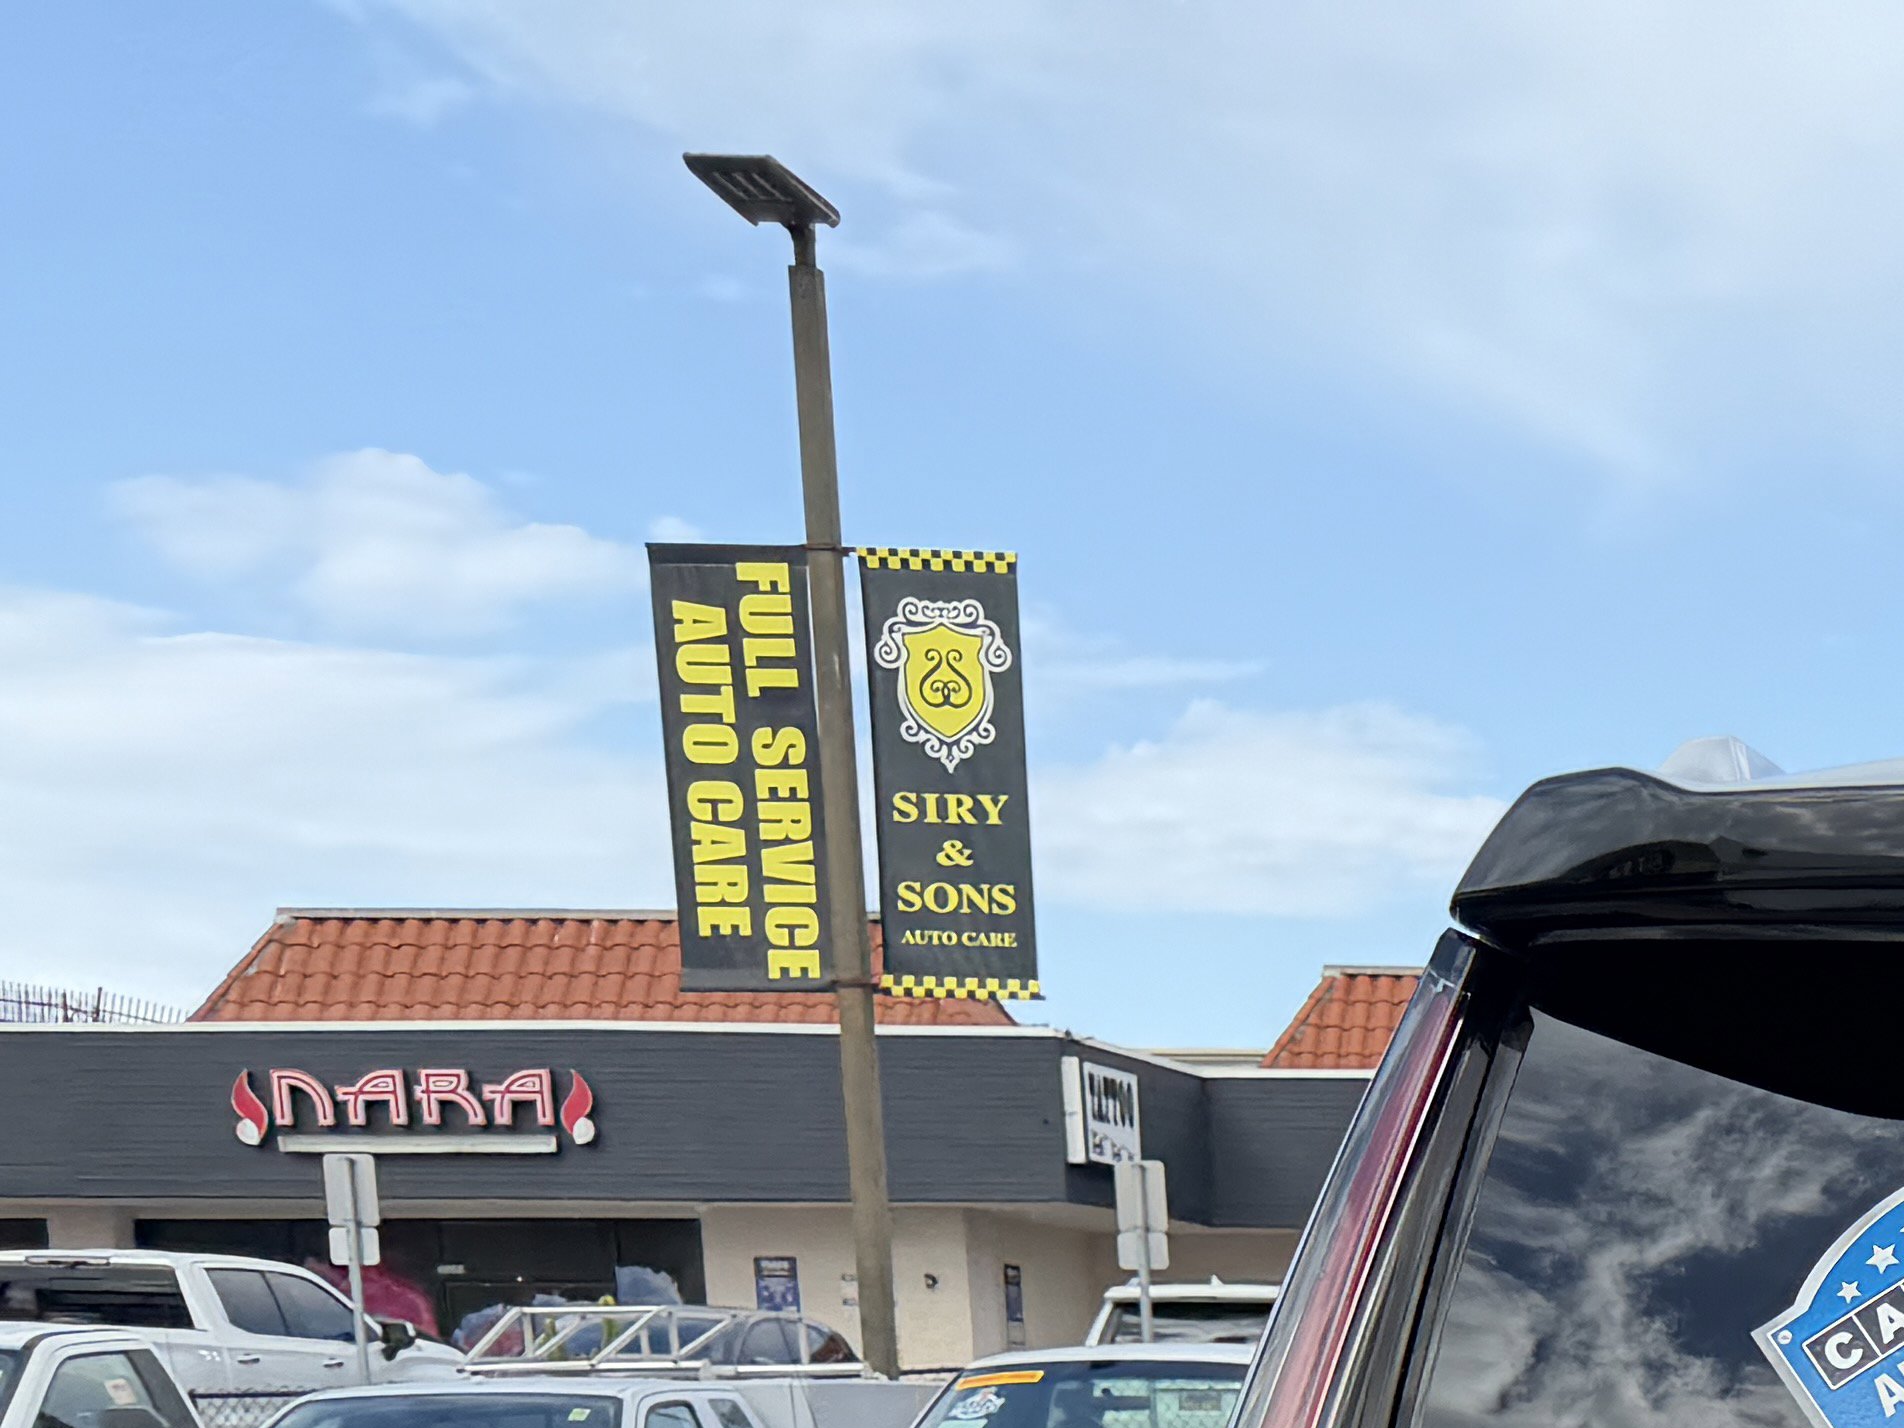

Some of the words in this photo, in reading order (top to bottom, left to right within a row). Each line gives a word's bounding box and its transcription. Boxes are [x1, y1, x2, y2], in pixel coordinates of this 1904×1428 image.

[736, 562, 800, 698] FULL
[671, 600, 740, 765] AUTO
[892, 791, 1009, 825] SIRY
[687, 780, 752, 938] CARE
[752, 726, 821, 980] SERVICE
[935, 840, 973, 867] &
[897, 881, 1017, 916] SONS
[902, 929, 959, 946] AUTO
[961, 931, 1018, 948] CARE
[268, 1067, 556, 1127] NARA
